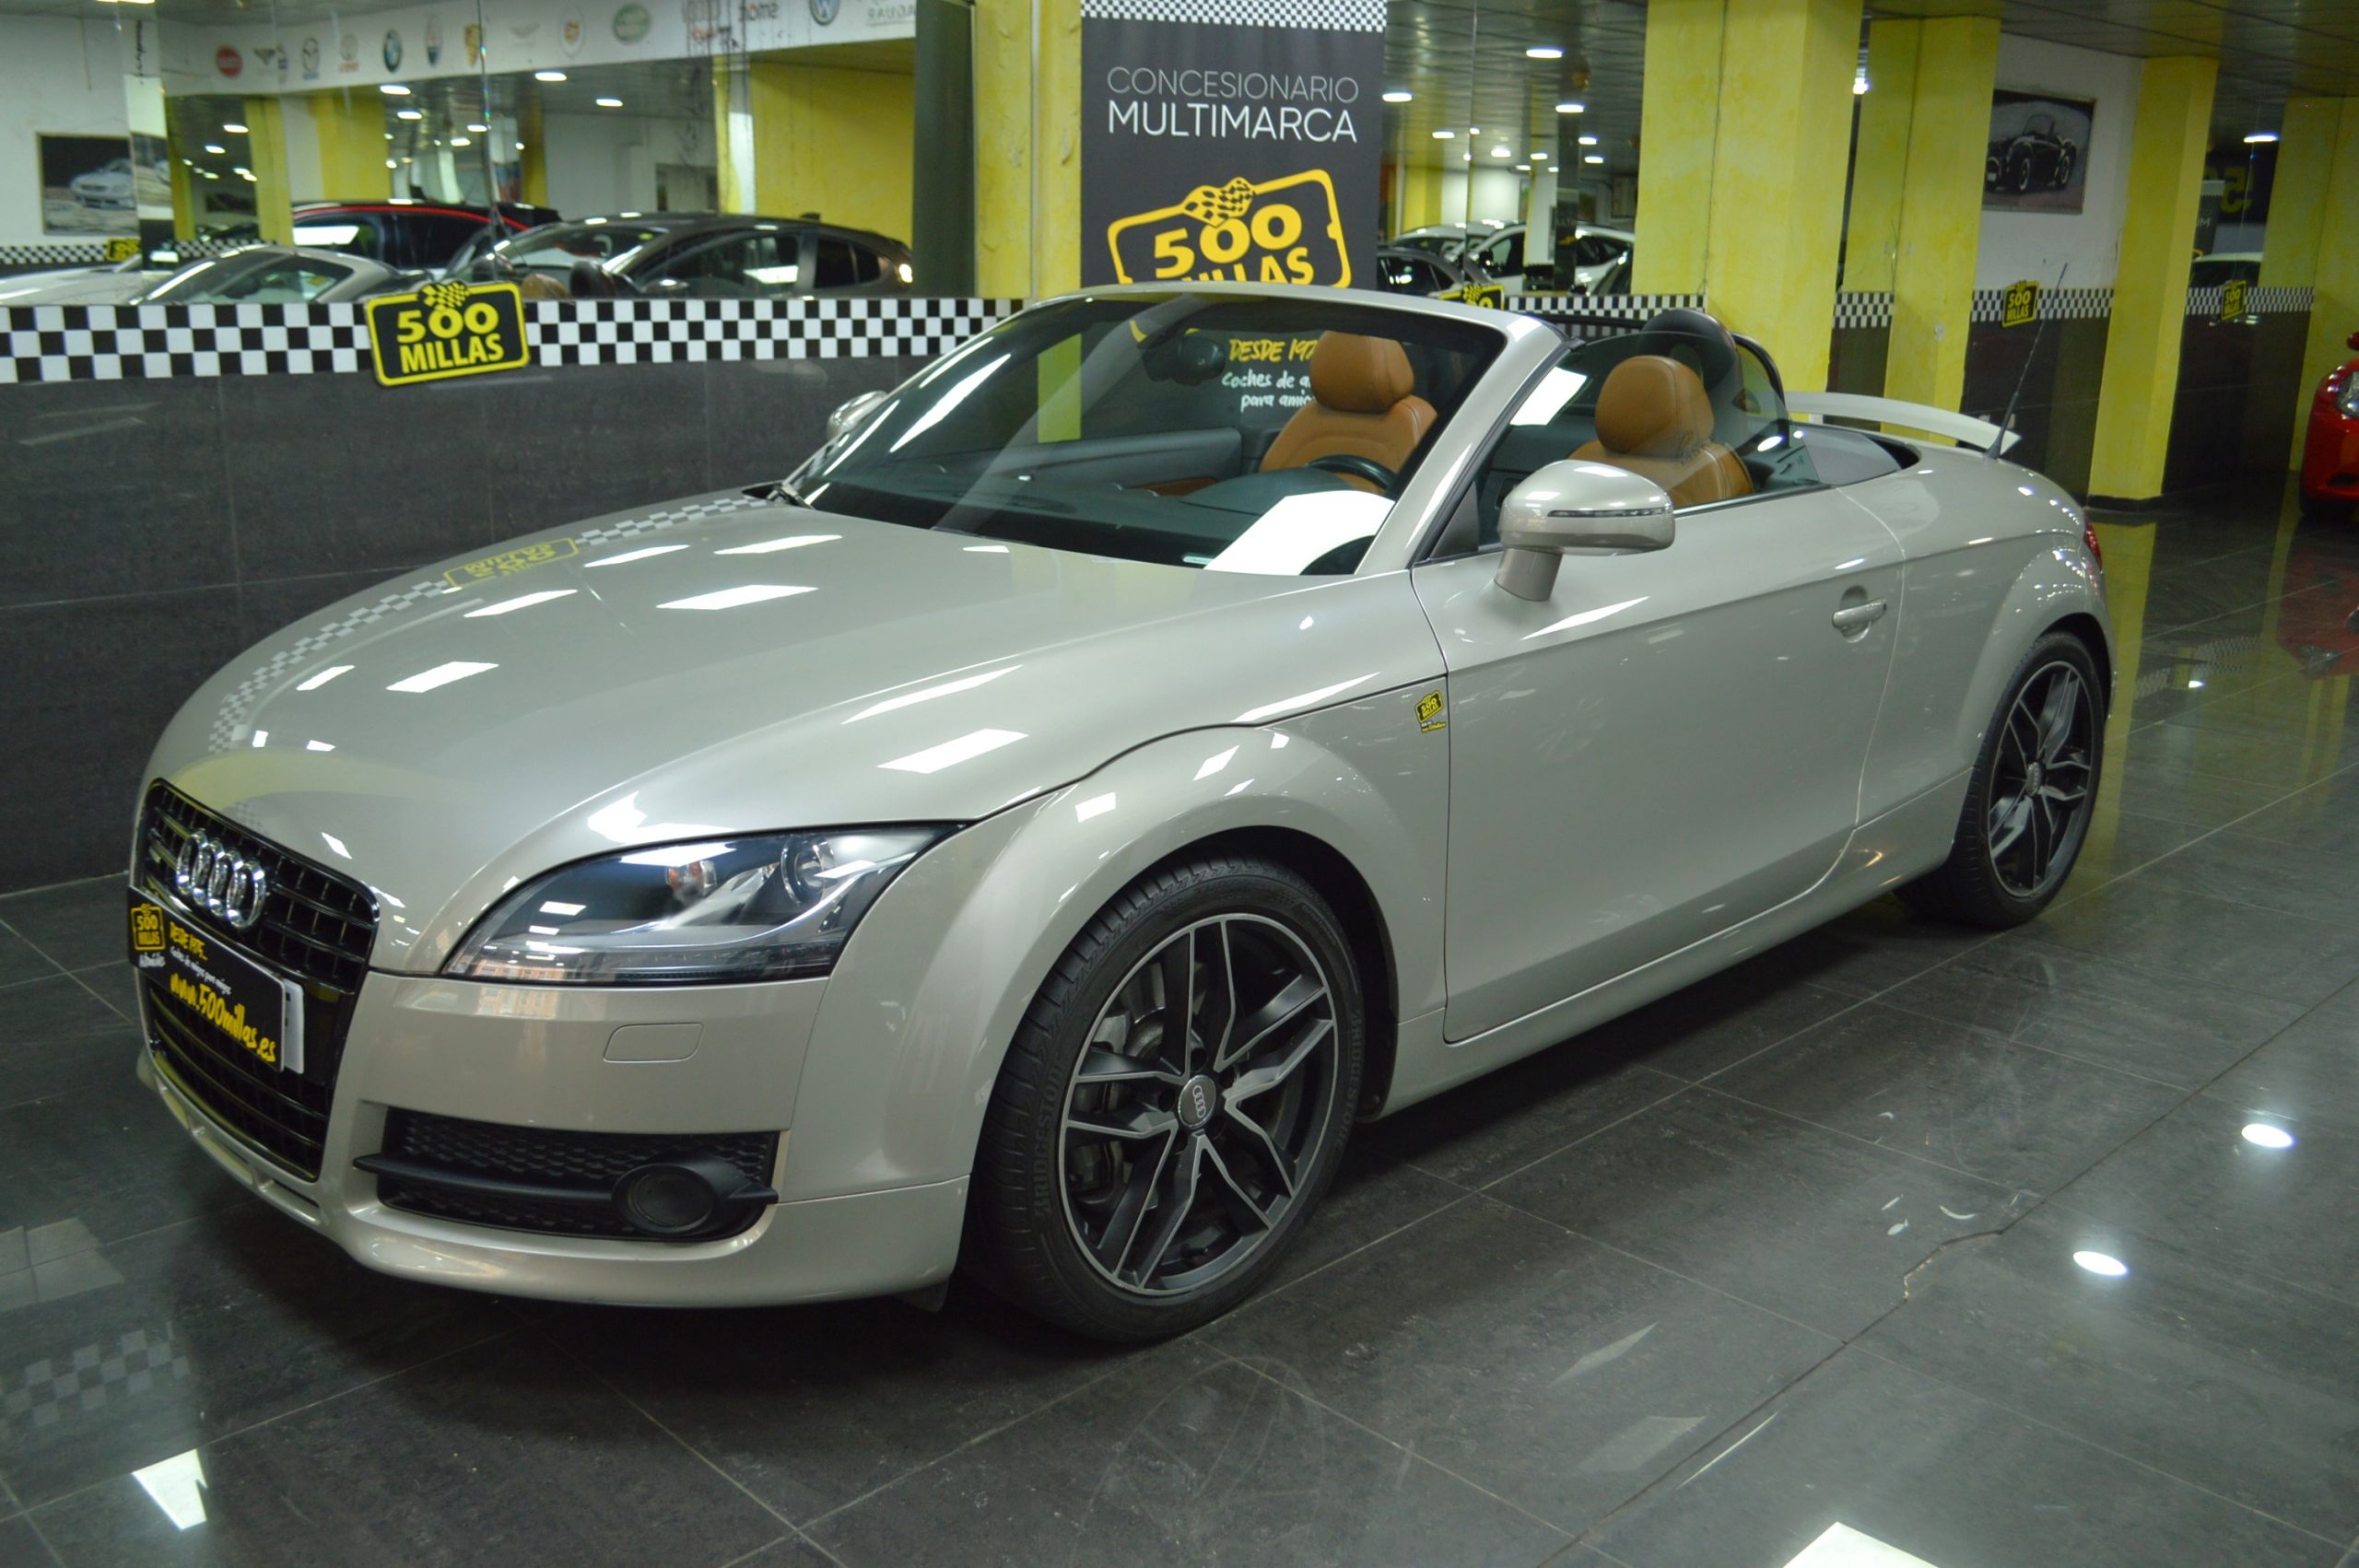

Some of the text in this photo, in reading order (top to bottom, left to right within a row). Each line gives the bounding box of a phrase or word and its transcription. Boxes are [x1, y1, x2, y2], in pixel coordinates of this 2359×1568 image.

[1107, 66, 1358, 103] CONCESIONARIO
[1109, 99, 1357, 143] MULTIMARCA
[1154, 204, 1302, 278] 500
[2008, 290, 2031, 309] 500
[397, 302, 499, 344] 500
[399, 333, 504, 373] MILLAS
[1229, 338, 1318, 363] DESDE 197
[1222, 369, 1272, 389] Coches
[1276, 369, 1295, 389] de
[1240, 389, 1315, 413] para ami
[136, 916, 158, 930] 500
[170, 972, 276, 1062] www.500millas.es
